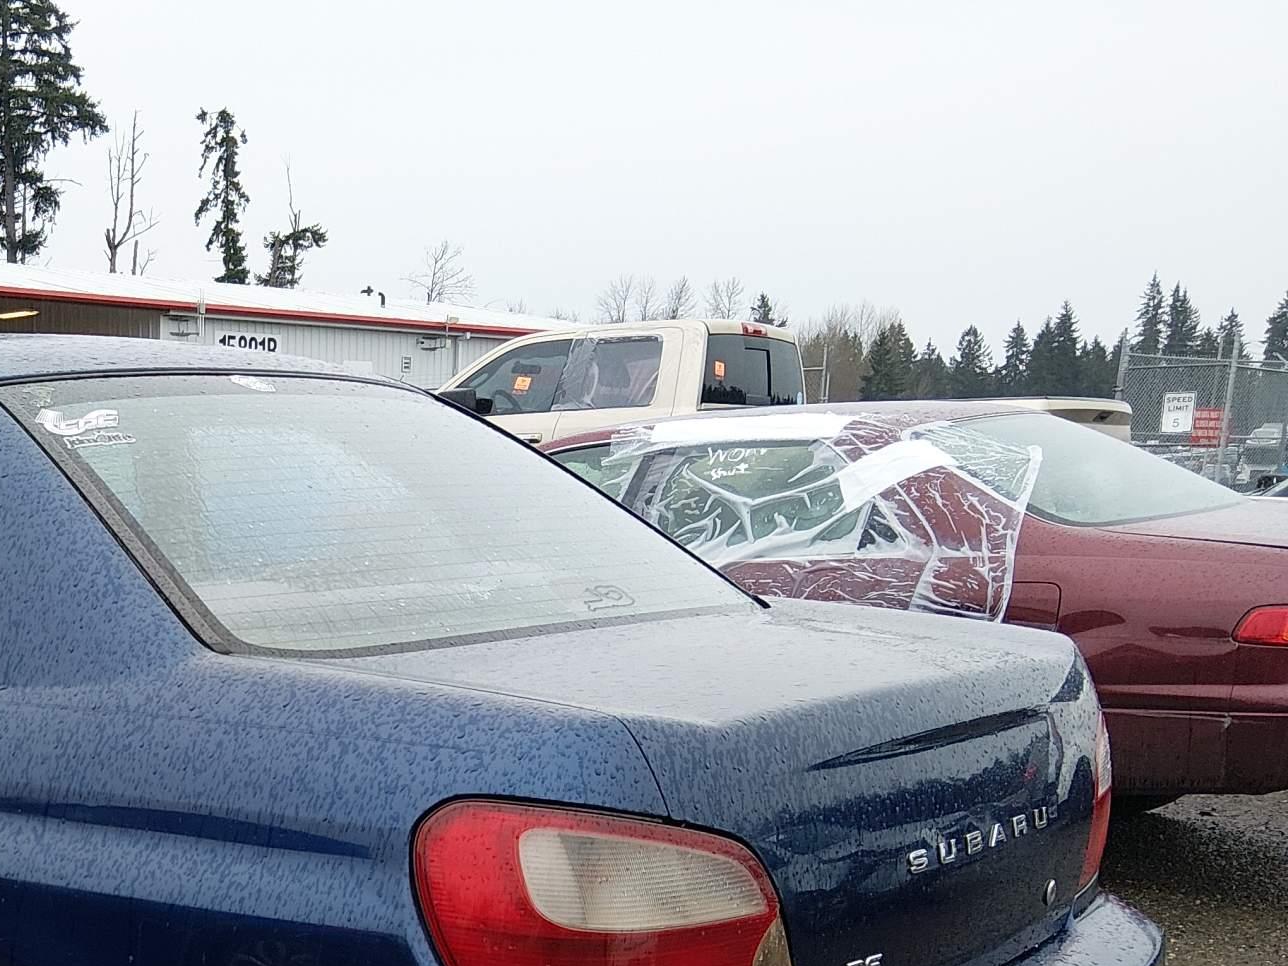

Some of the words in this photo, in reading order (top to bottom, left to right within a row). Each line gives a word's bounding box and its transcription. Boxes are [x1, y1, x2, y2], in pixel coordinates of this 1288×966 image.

[1166, 396, 1193, 404] SPEED
[1171, 417, 1180, 428] 5
[908, 806, 1049, 874] SUBARU
